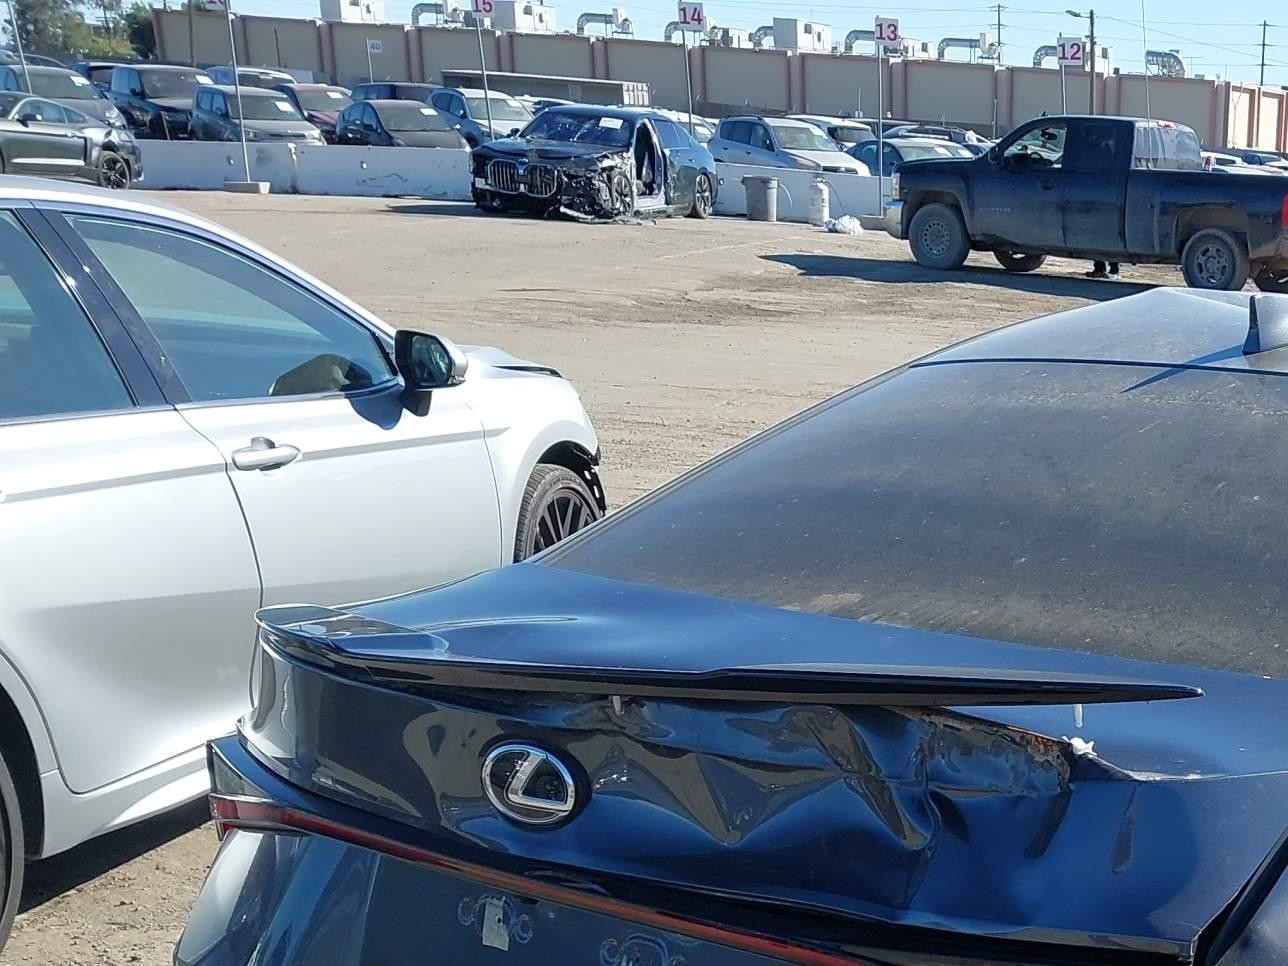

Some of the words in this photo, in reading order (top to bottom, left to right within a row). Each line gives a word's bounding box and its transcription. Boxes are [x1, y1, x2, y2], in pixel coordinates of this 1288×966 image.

[473, 0, 492, 13] 15
[679, 6, 703, 26] 14
[875, 22, 898, 42] 13
[1058, 42, 1081, 61] 12
